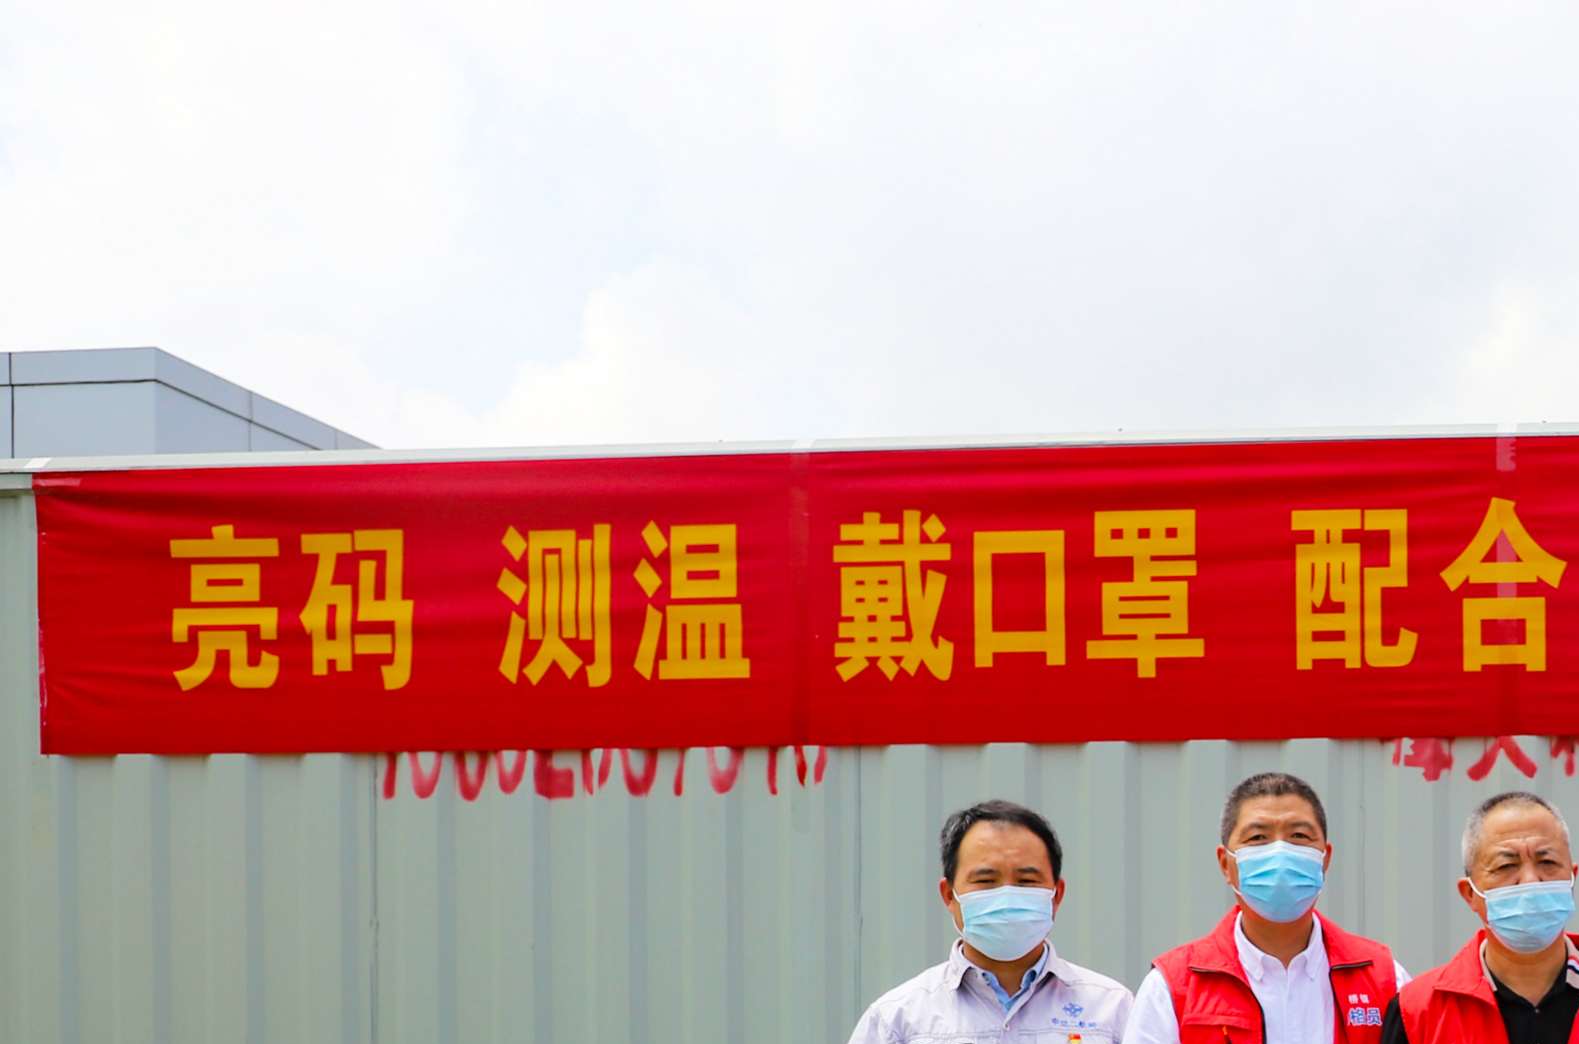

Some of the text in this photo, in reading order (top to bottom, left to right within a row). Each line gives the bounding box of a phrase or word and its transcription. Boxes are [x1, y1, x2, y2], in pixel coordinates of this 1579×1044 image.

[169, 525, 414, 691] 亮码
[496, 521, 750, 687] 测温
[832, 508, 1205, 681] 戴口罩
